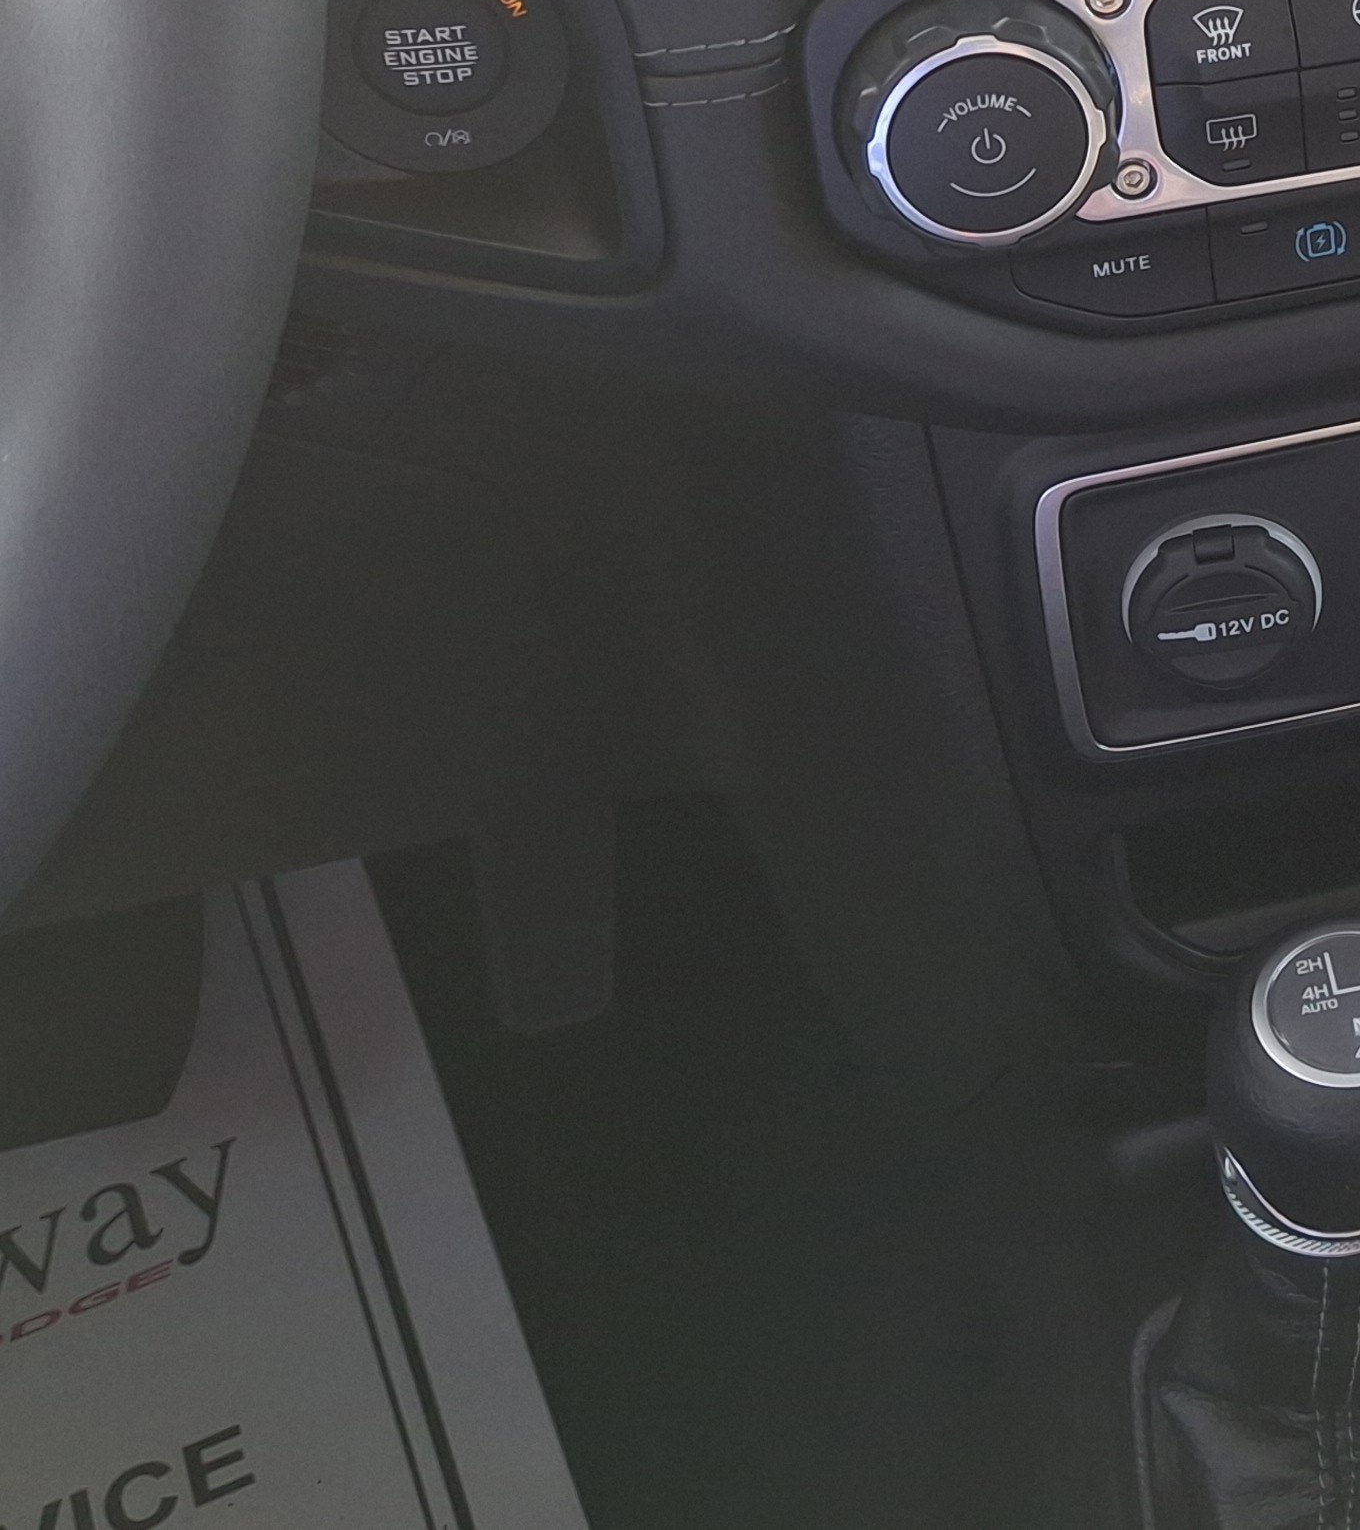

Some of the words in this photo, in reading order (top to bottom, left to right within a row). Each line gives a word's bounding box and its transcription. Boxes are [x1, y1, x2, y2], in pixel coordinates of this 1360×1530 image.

[385, 25, 467, 46] START
[383, 45, 479, 67] ENGINE
[1196, 42, 1252, 64] FRONT
[403, 67, 473, 87] STOP
[943, 94, 1019, 126] VOLUME
[1092, 254, 1152, 279] MUTE
[1218, 616, 1256, 638] 12V
[1259, 608, 1291, 631] DC
[1295, 956, 1323, 975] 2H
[1301, 983, 1330, 1001] 4H
[1301, 998, 1338, 1016] AUTO
